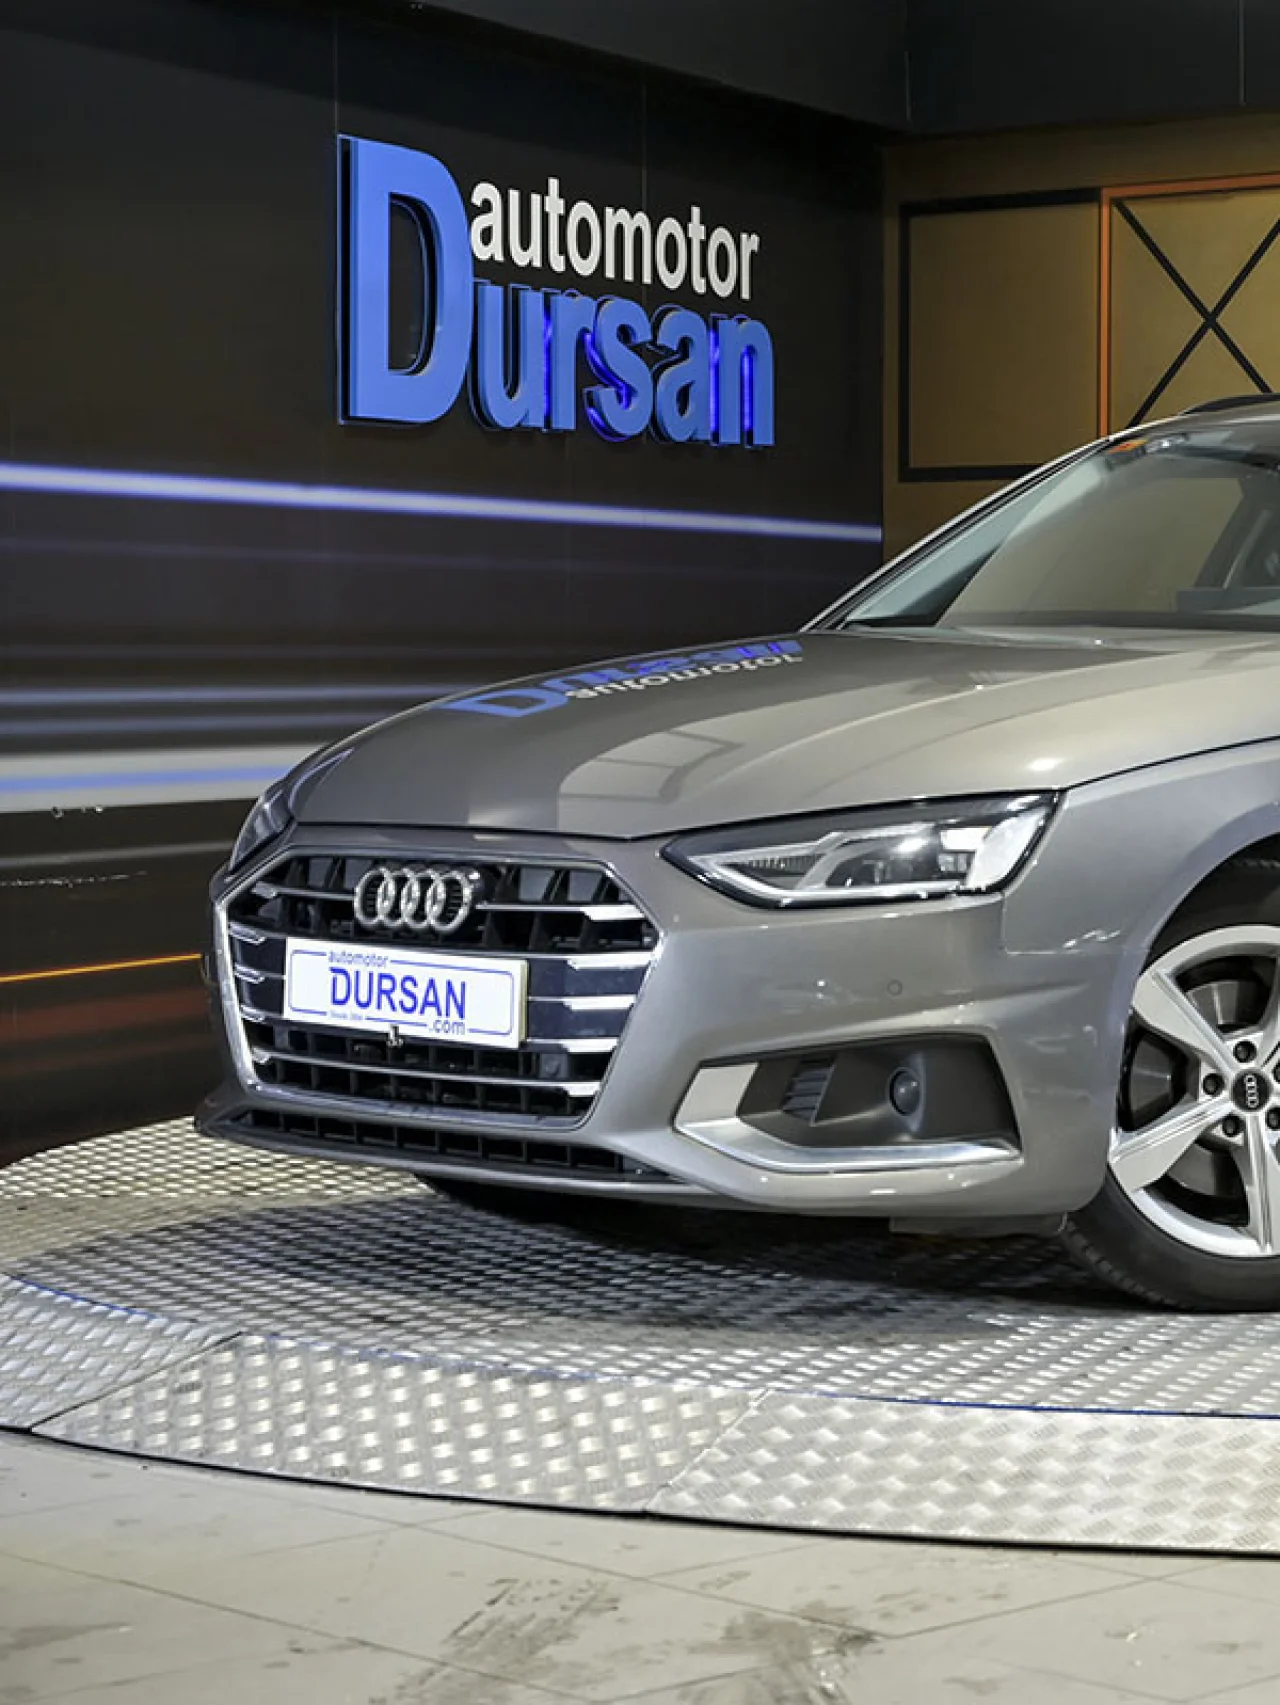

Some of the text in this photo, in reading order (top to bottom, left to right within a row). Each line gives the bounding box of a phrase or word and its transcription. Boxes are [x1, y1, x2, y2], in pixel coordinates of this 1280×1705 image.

[470, 176, 760, 300] automotor
[337, 134, 775, 447] Dursan
[328, 951, 389, 968] automotor
[329, 966, 466, 1019] DURSAN
[429, 1019, 466, 1035] .com
